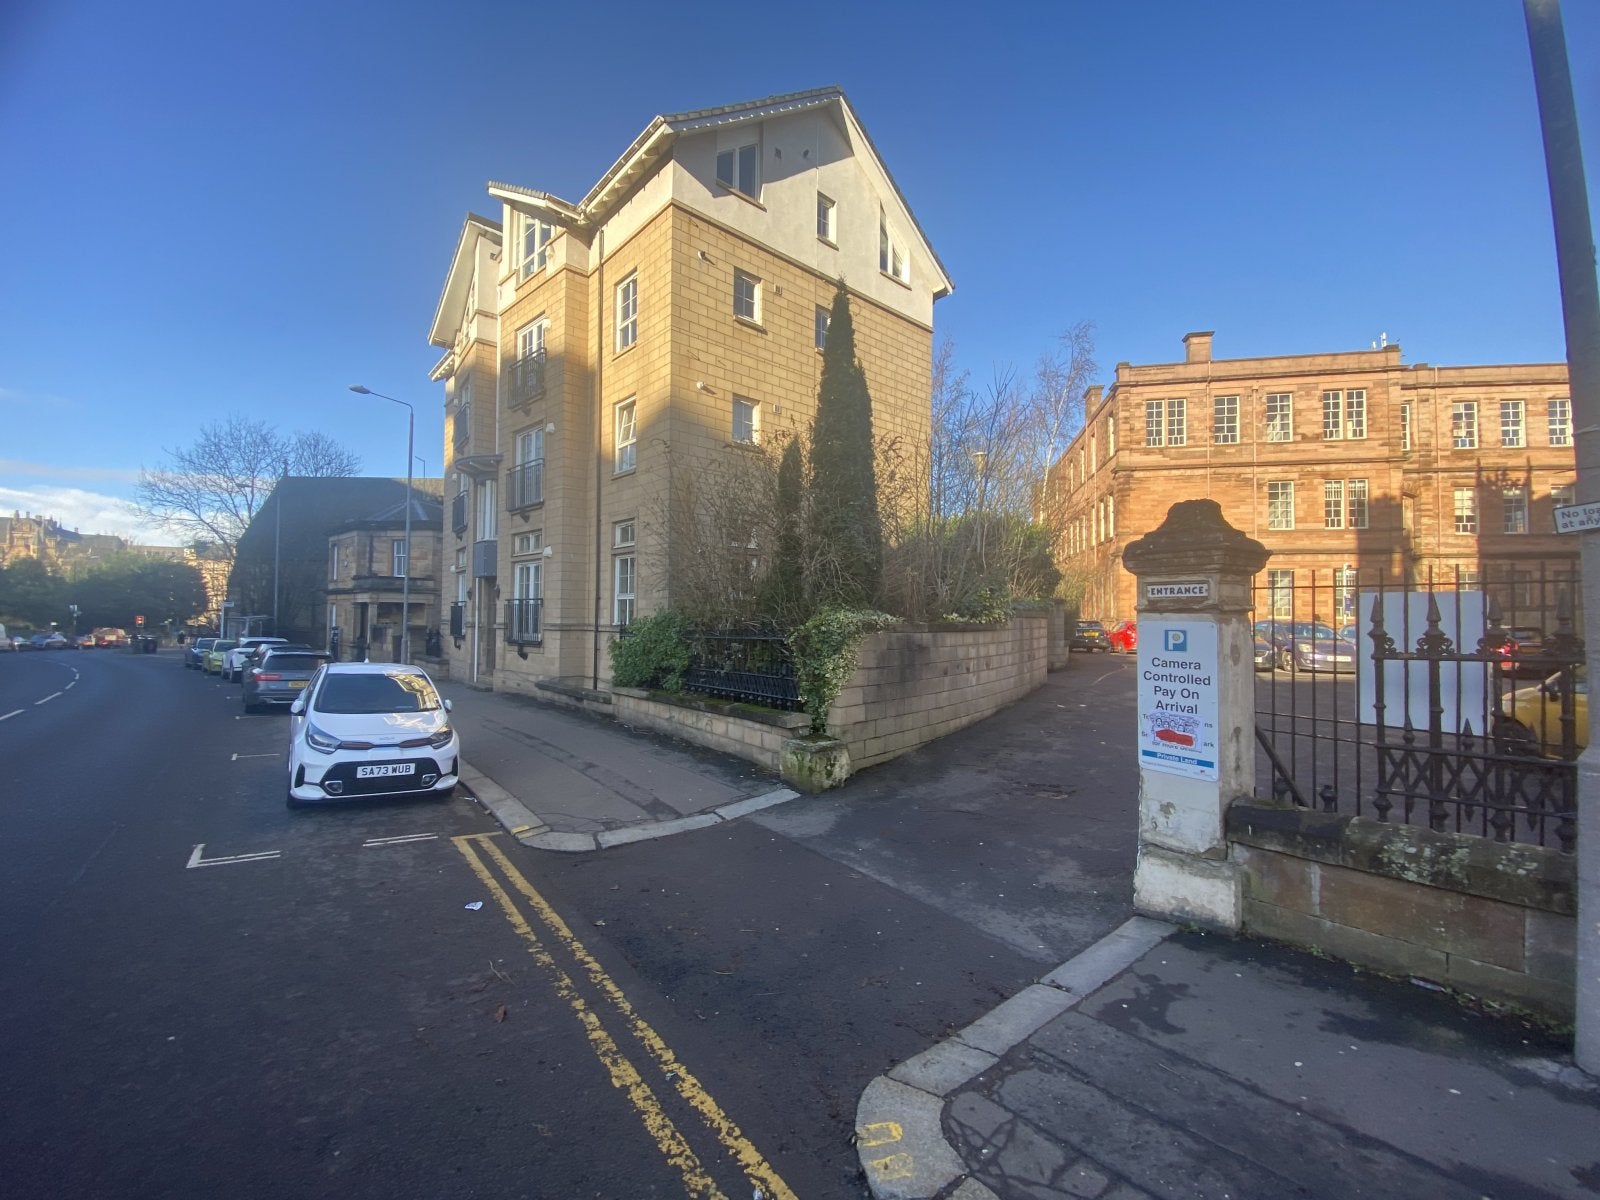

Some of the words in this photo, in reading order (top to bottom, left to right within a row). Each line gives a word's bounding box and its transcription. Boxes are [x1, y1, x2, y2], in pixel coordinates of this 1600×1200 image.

[1561, 510, 1579, 519] No
[1561, 520, 1574, 528] at
[1150, 586, 1204, 596] ENTRANCE
[1168, 630, 1184, 651] P
[1151, 657, 1201, 670] Camera
[1143, 670, 1211, 686] Controlled
[1154, 685, 1176, 700] Pay
[1180, 688, 1200, 700] On
[1155, 700, 1198, 715] Arrival
[1156, 752, 1180, 761] Private
[1180, 756, 1198, 765] Land
[361, 766, 389, 776] SA73
[391, 764, 411, 774] WUB
